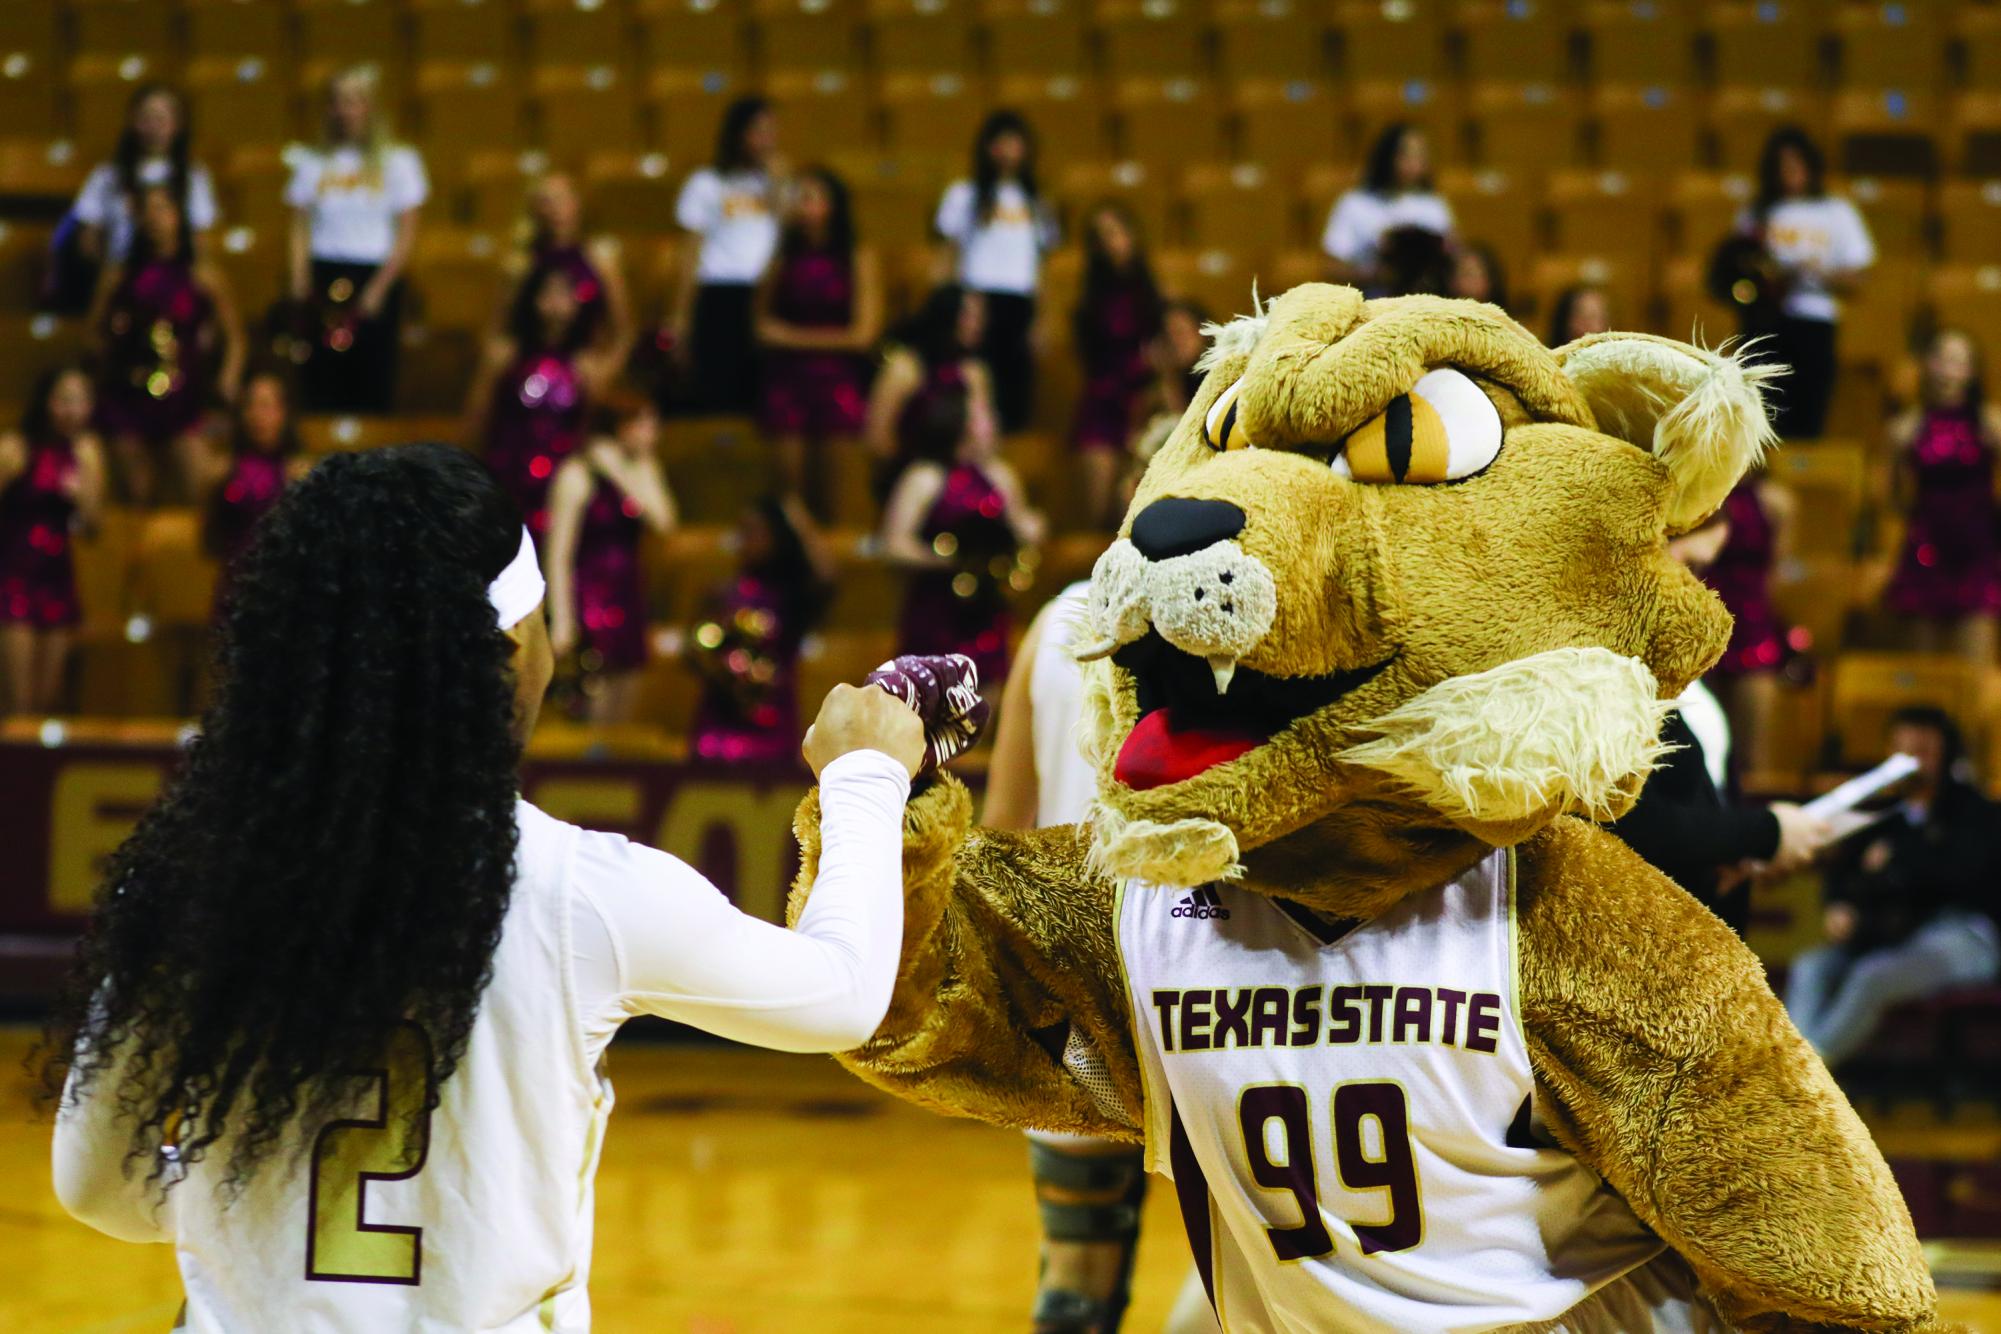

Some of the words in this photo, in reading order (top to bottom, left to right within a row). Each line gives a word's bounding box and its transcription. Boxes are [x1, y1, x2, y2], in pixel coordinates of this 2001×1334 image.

[1171, 904, 1230, 920] adidas
[1152, 984, 1323, 1053] TEXAS
[1328, 984, 1501, 1055] STATE
[305, 1018, 433, 1286] 2
[1237, 1078, 1425, 1265] 99
